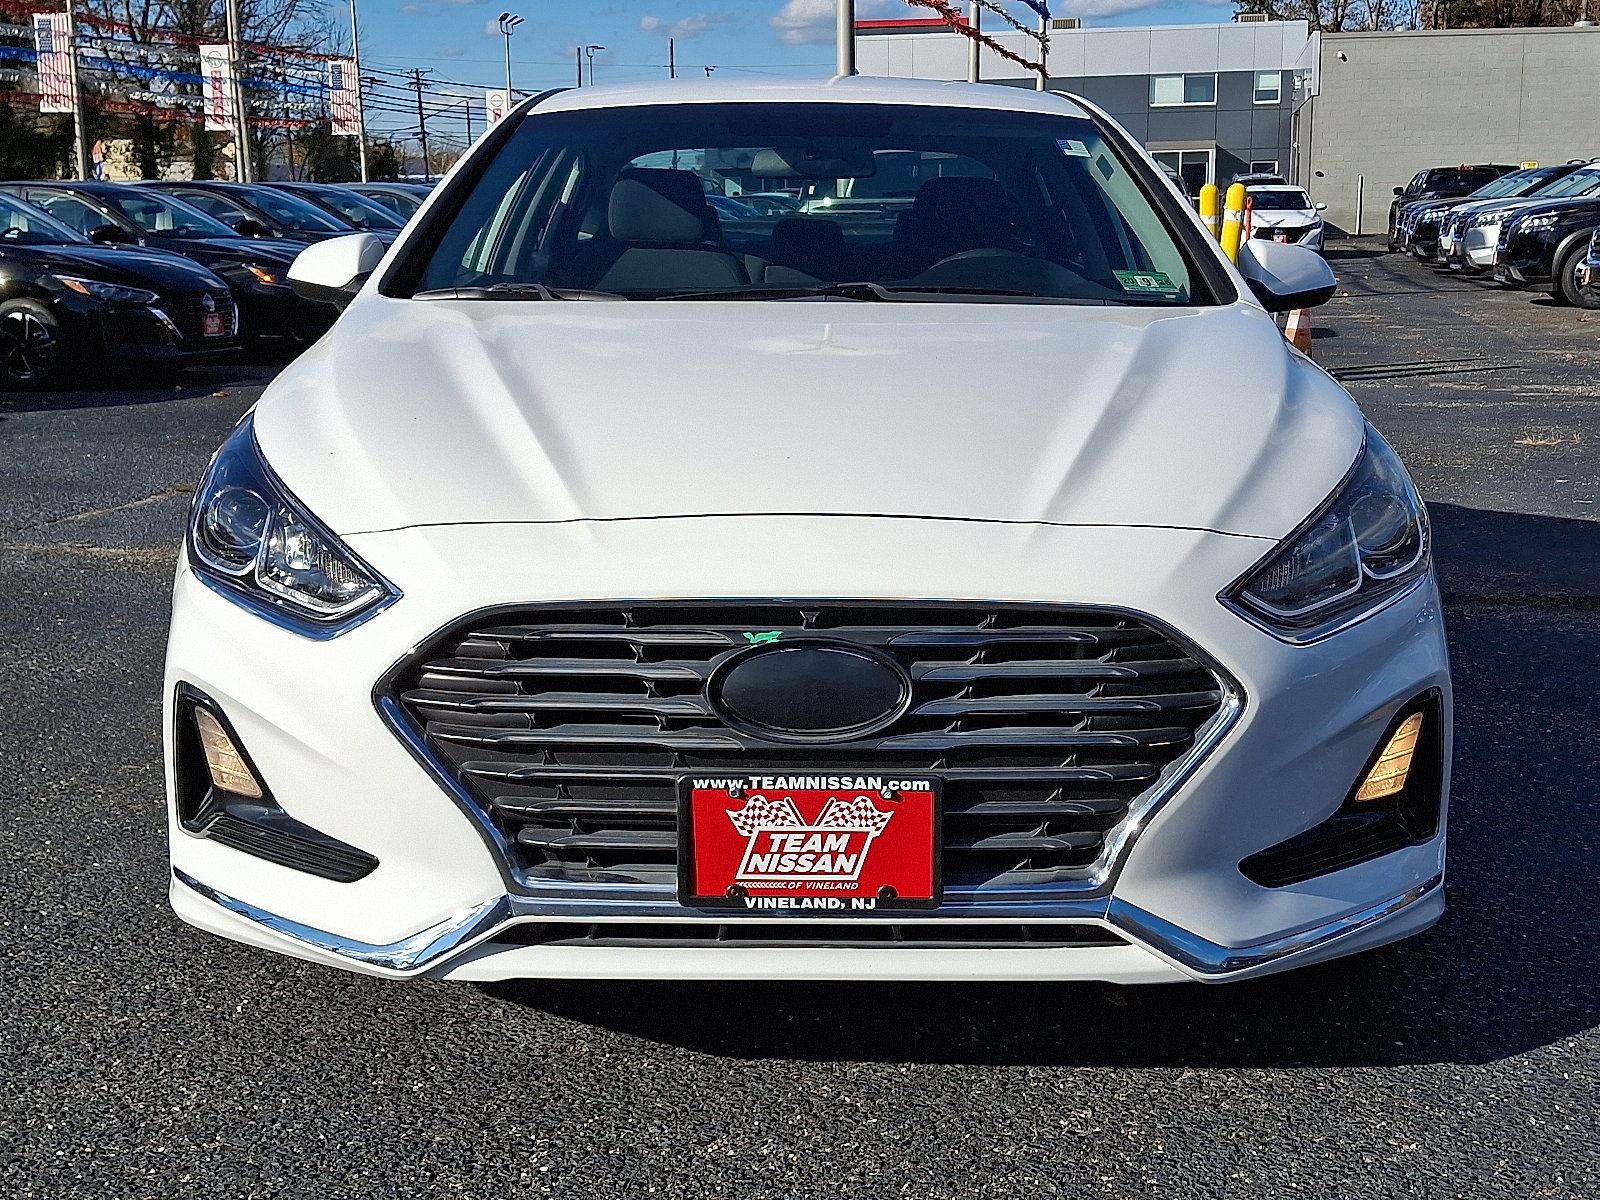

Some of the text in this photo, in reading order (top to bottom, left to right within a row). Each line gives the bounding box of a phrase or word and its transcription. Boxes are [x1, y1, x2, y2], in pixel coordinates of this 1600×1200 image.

[1141, 277, 1152, 287] 9
[693, 776, 931, 791] www.TEAMNISSAN.com
[768, 833, 851, 853] TEAM
[746, 853, 858, 873] NISSAN
[787, 880, 859, 890] OF VINELAND
[744, 896, 877, 910] VINELAND, NJ
